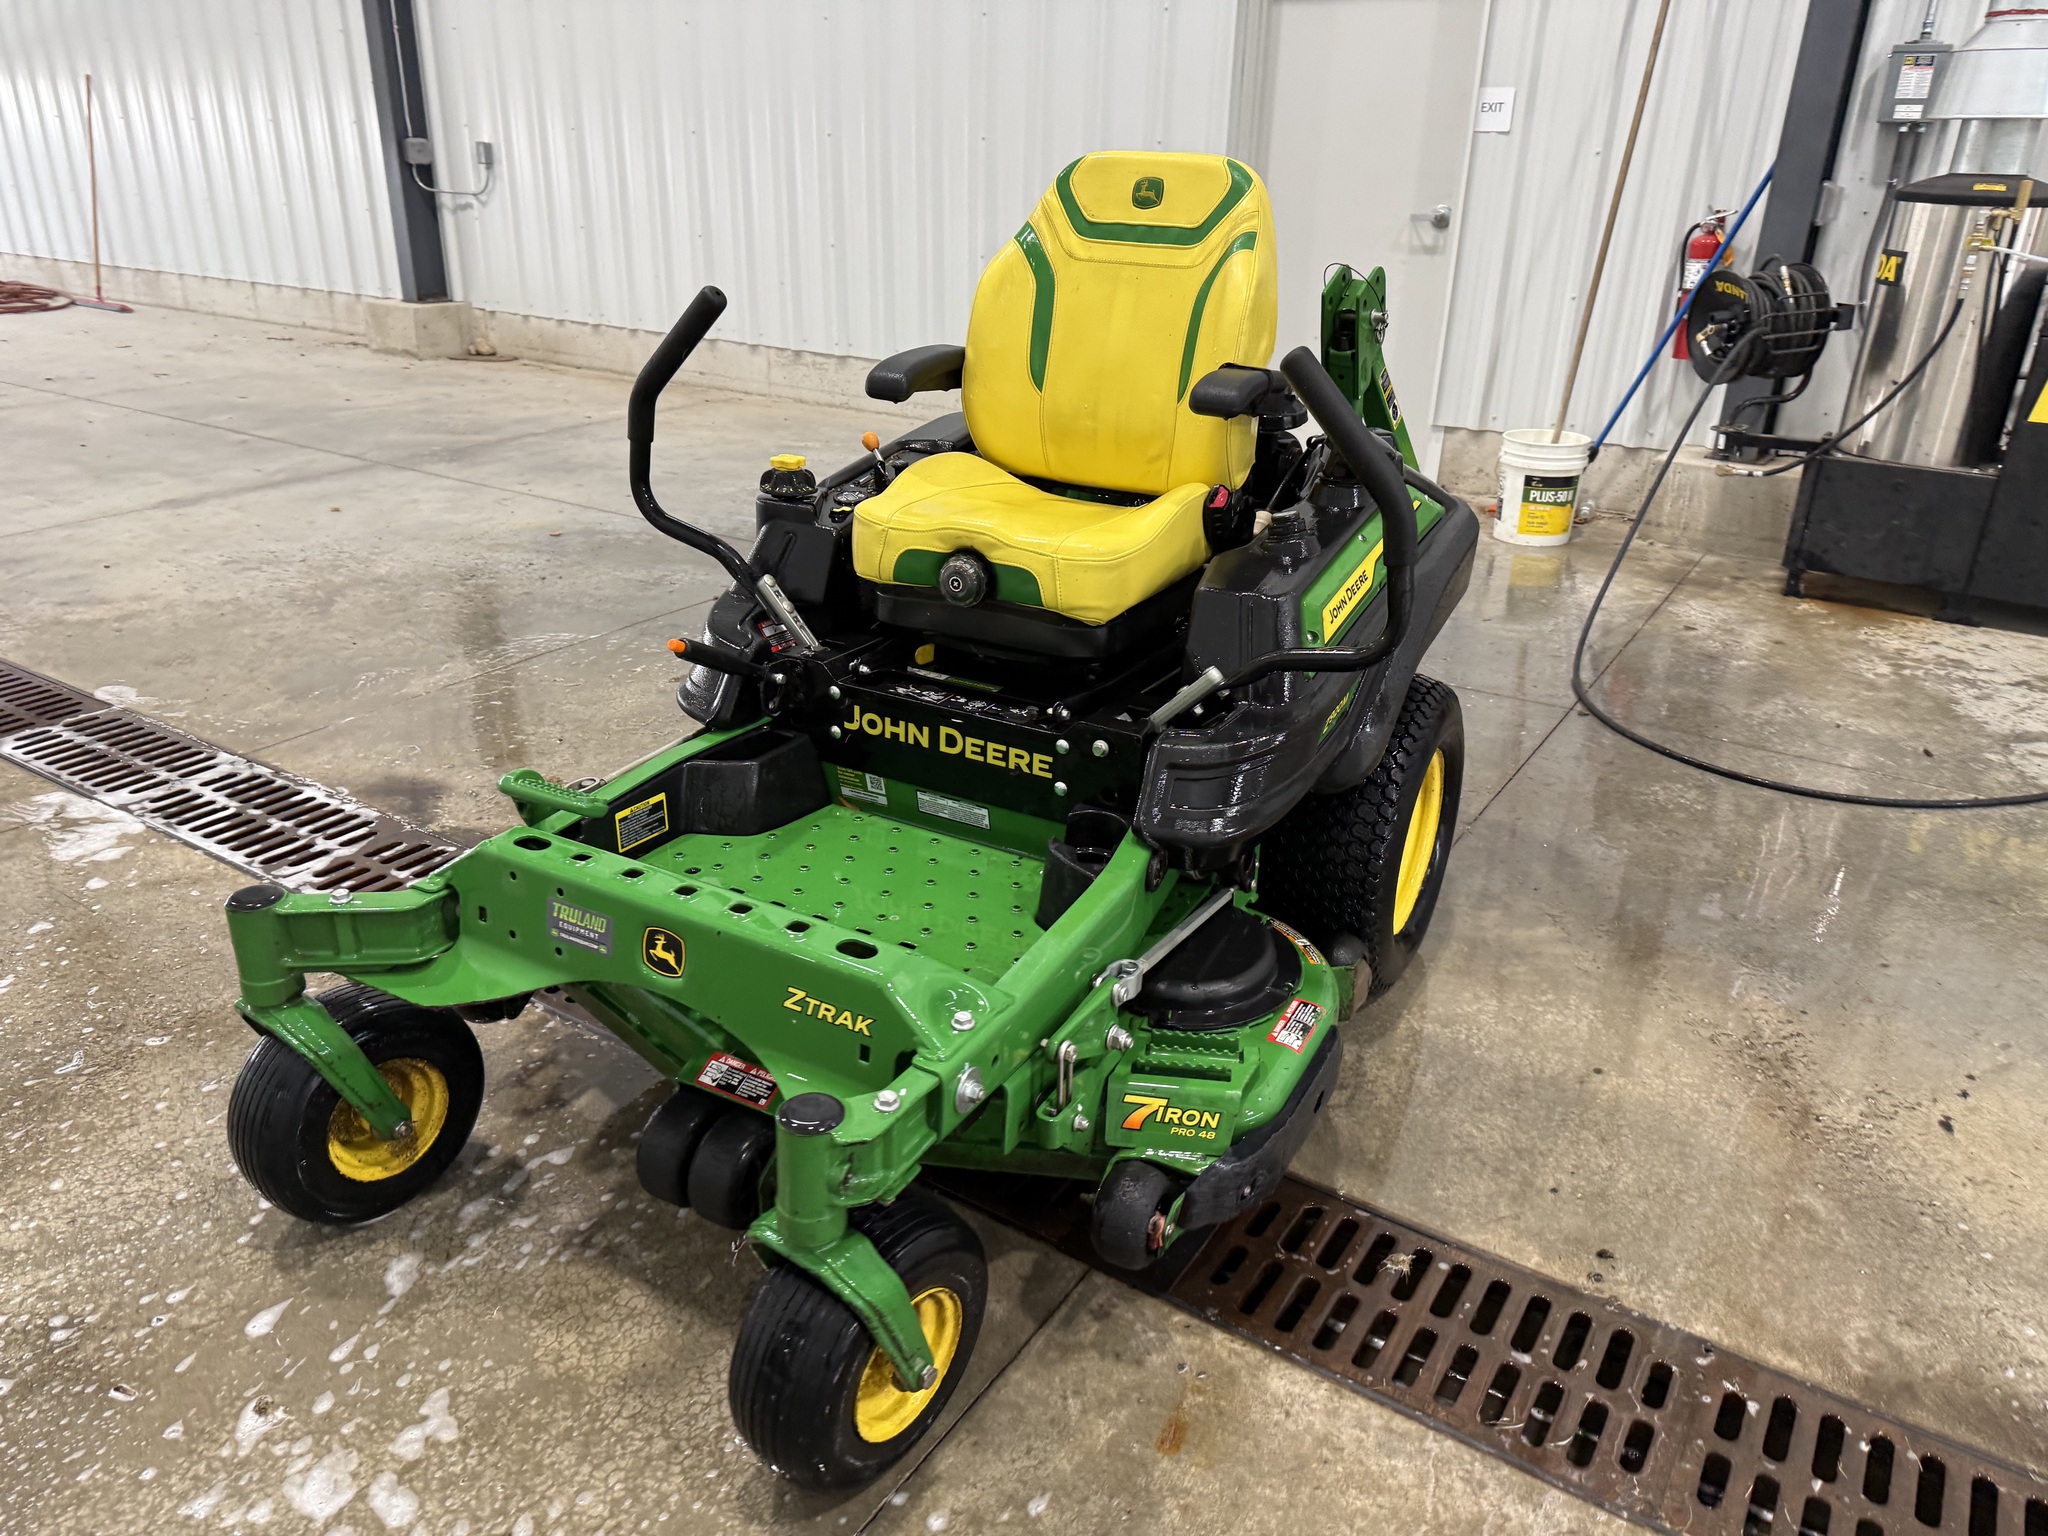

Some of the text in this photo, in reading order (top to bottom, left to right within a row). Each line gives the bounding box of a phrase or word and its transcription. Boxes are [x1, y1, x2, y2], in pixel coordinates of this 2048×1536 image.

[1481, 102, 1505, 113] EXIT
[1529, 489, 1568, 503] PLUS-50
[1328, 569, 1369, 625] JOHN DEERE
[843, 704, 1054, 779] JOHN DEERE
[552, 901, 607, 934] TRULAND
[558, 921, 599, 940] EQUIPMENT
[782, 986, 875, 1037] ZTRAK
[725, 1058, 747, 1070] DANGER
[1170, 1127, 1217, 1140] PRO 48
